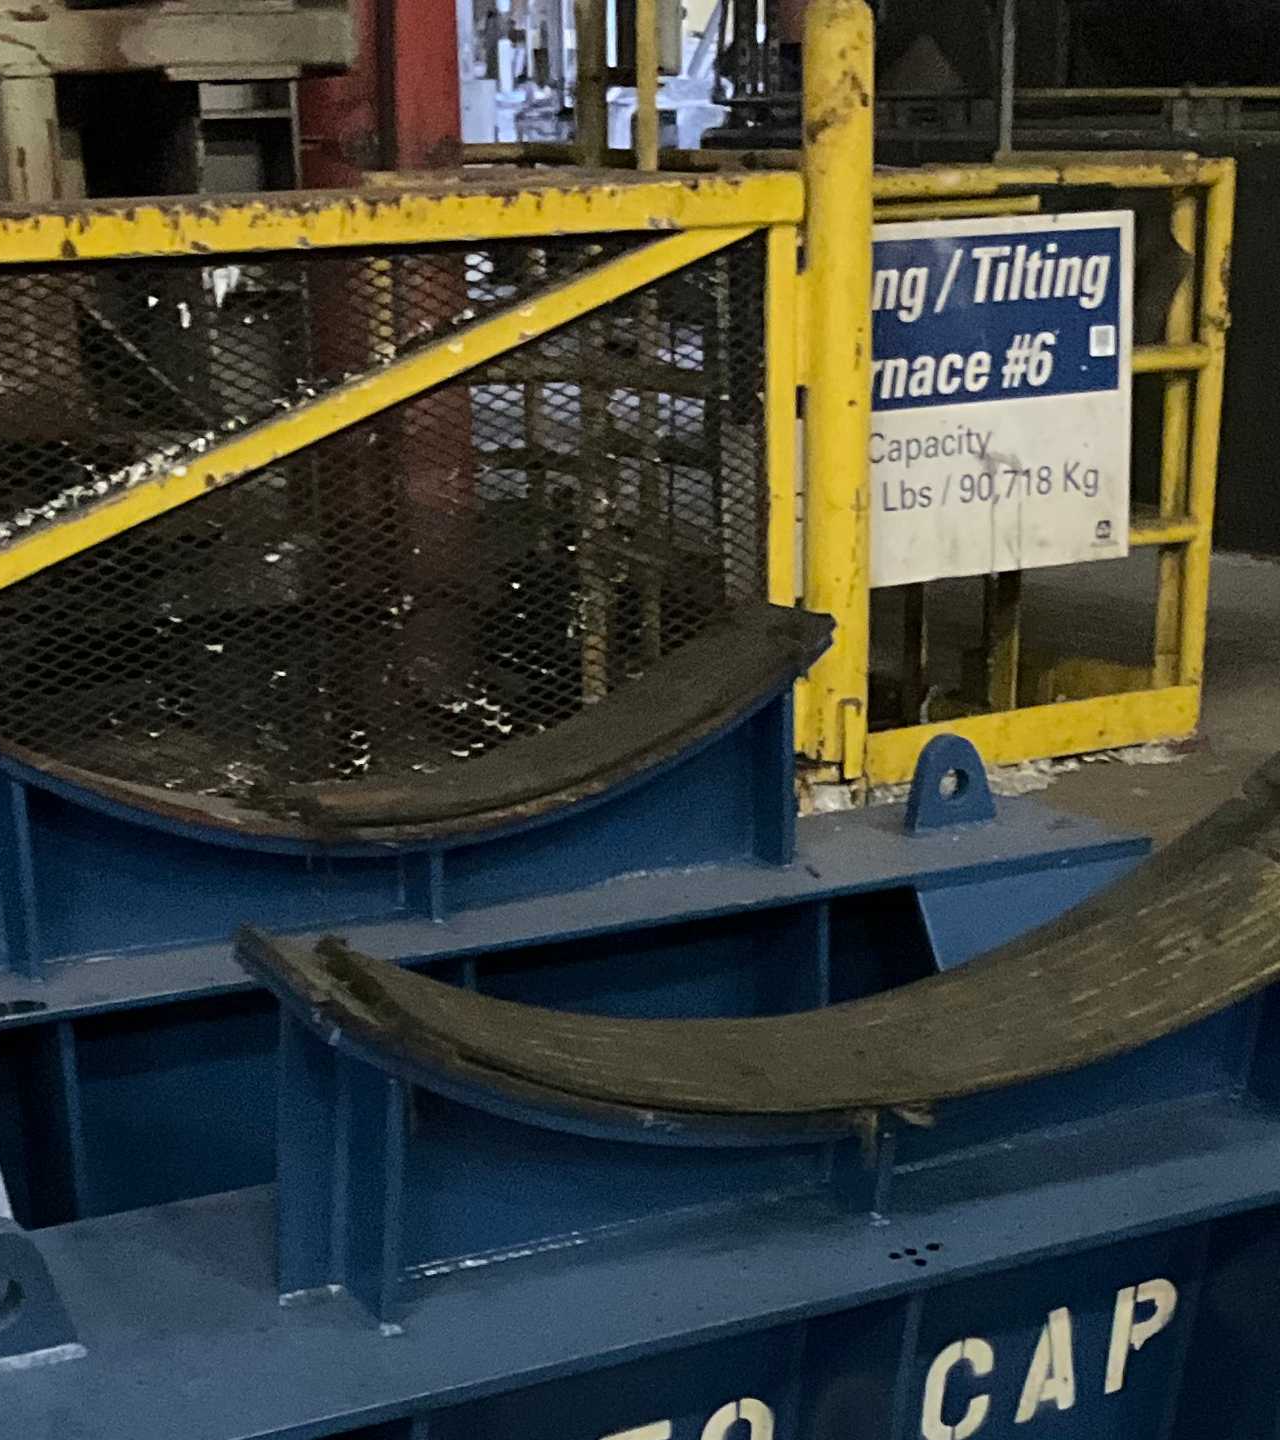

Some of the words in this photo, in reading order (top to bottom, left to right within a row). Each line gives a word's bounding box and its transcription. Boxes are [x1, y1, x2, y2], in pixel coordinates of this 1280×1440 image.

[933, 248, 964, 314] /
[971, 242, 1111, 310] Tilting
[1001, 330, 1056, 390] #6
[867, 424, 993, 469] Capacity
[882, 478, 933, 512] Lbs
[941, 474, 952, 506] /
[959, 464, 1053, 505] 90,718
[1063, 461, 1100, 498] Kg
